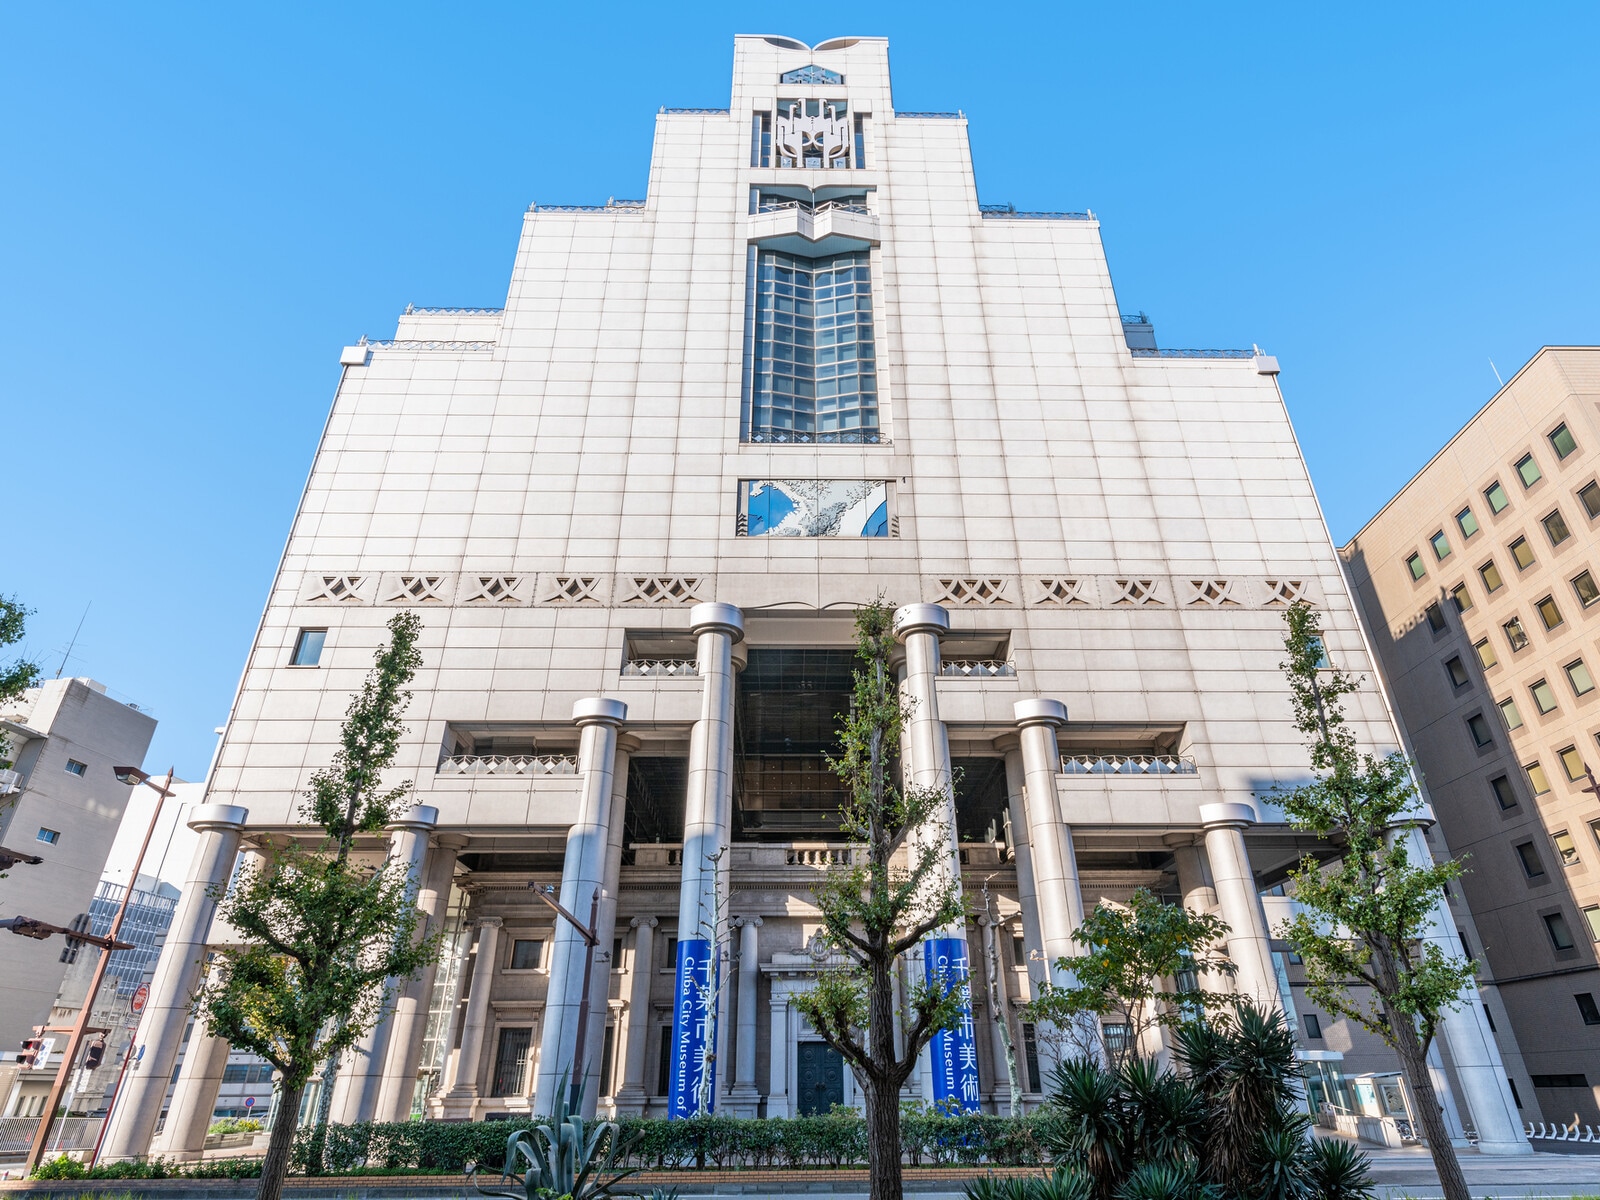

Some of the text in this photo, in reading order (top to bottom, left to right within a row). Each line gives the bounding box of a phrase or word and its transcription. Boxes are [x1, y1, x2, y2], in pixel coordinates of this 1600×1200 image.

[683, 957, 695, 996] Chiba
[679, 1000, 692, 1028] City
[677, 1031, 691, 1092] Museum
[943, 1029, 955, 1090] Museum
[676, 1096, 687, 1112] of
